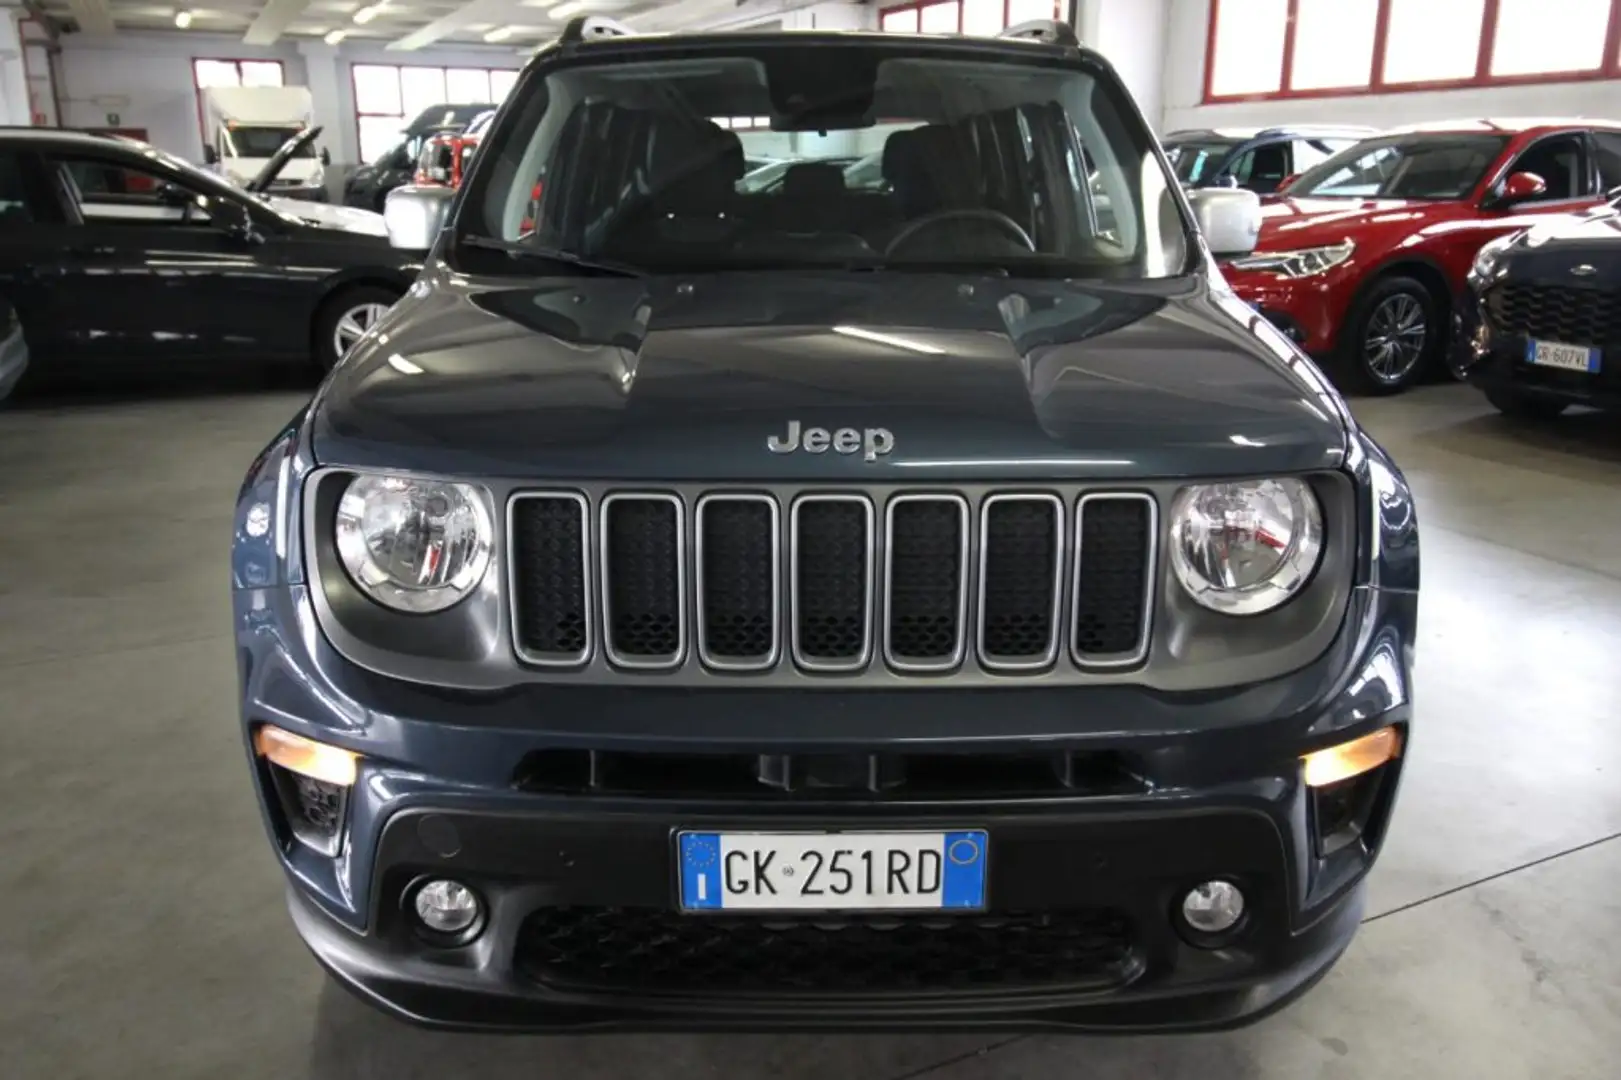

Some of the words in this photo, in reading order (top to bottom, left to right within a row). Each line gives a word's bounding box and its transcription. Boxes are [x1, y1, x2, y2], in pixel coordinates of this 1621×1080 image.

[767, 420, 894, 461] Jeep
[724, 849, 778, 896] GK
[799, 849, 942, 896] 251RD
